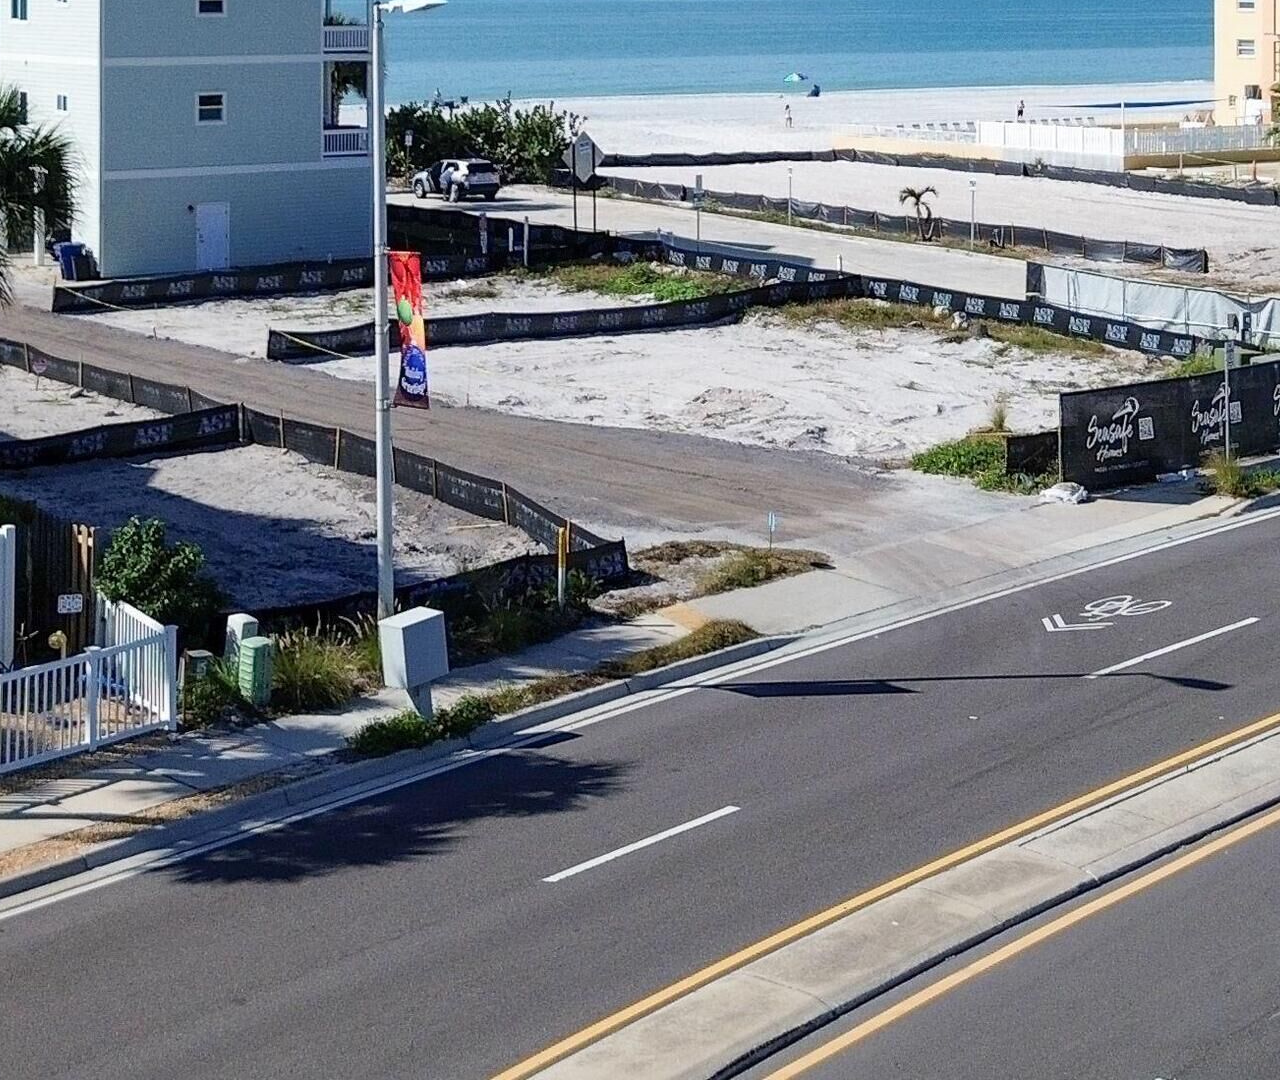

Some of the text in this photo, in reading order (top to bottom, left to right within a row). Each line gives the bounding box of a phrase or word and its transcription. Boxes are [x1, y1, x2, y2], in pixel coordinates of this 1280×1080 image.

[669, 251, 685, 265] ASF
[696, 256, 711, 269] ASF
[722, 259, 739, 273] ASF
[749, 264, 767, 277] ASF
[777, 266, 796, 280] ASF
[899, 285, 919, 300] ASF
[965, 297, 985, 313] ASF
[999, 303, 1020, 318] ASF
[1034, 307, 1055, 323] ASF
[1069, 316, 1092, 333] ASF
[1105, 324, 1128, 340] ASF
[1139, 332, 1160, 348] ASF
[1172, 338, 1193, 353] ASF
[1086, 414, 1134, 453] Seasafe
[1097, 444, 1123, 462] Homes
